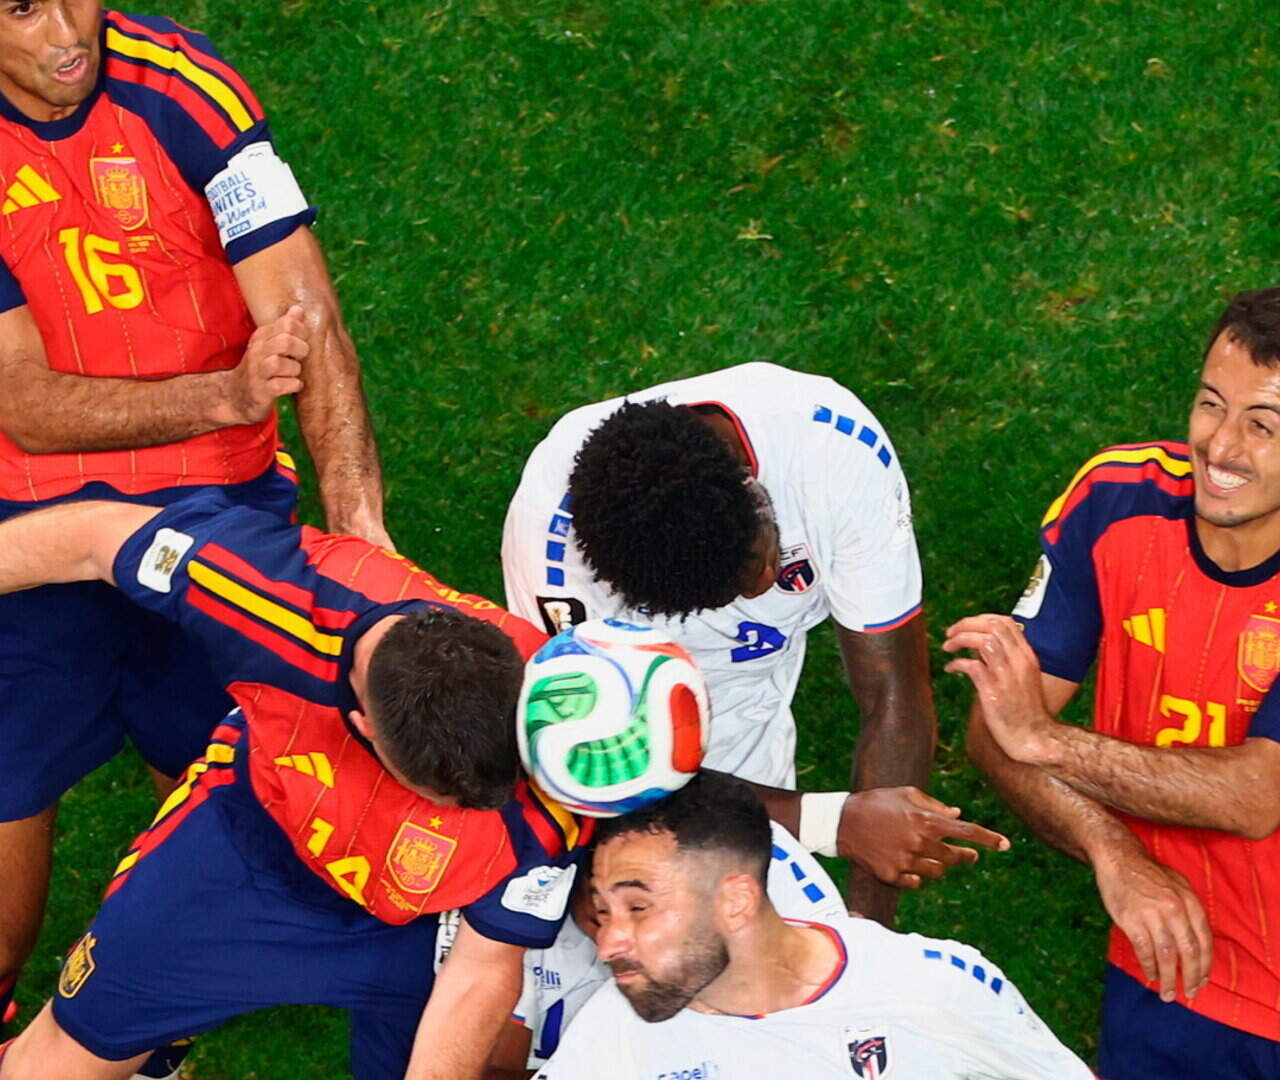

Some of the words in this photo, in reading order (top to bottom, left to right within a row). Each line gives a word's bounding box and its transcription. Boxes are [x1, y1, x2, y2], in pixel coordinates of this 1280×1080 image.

[213, 182, 257, 215] NITES
[58, 227, 144, 314] 16
[1155, 694, 1227, 747] 21
